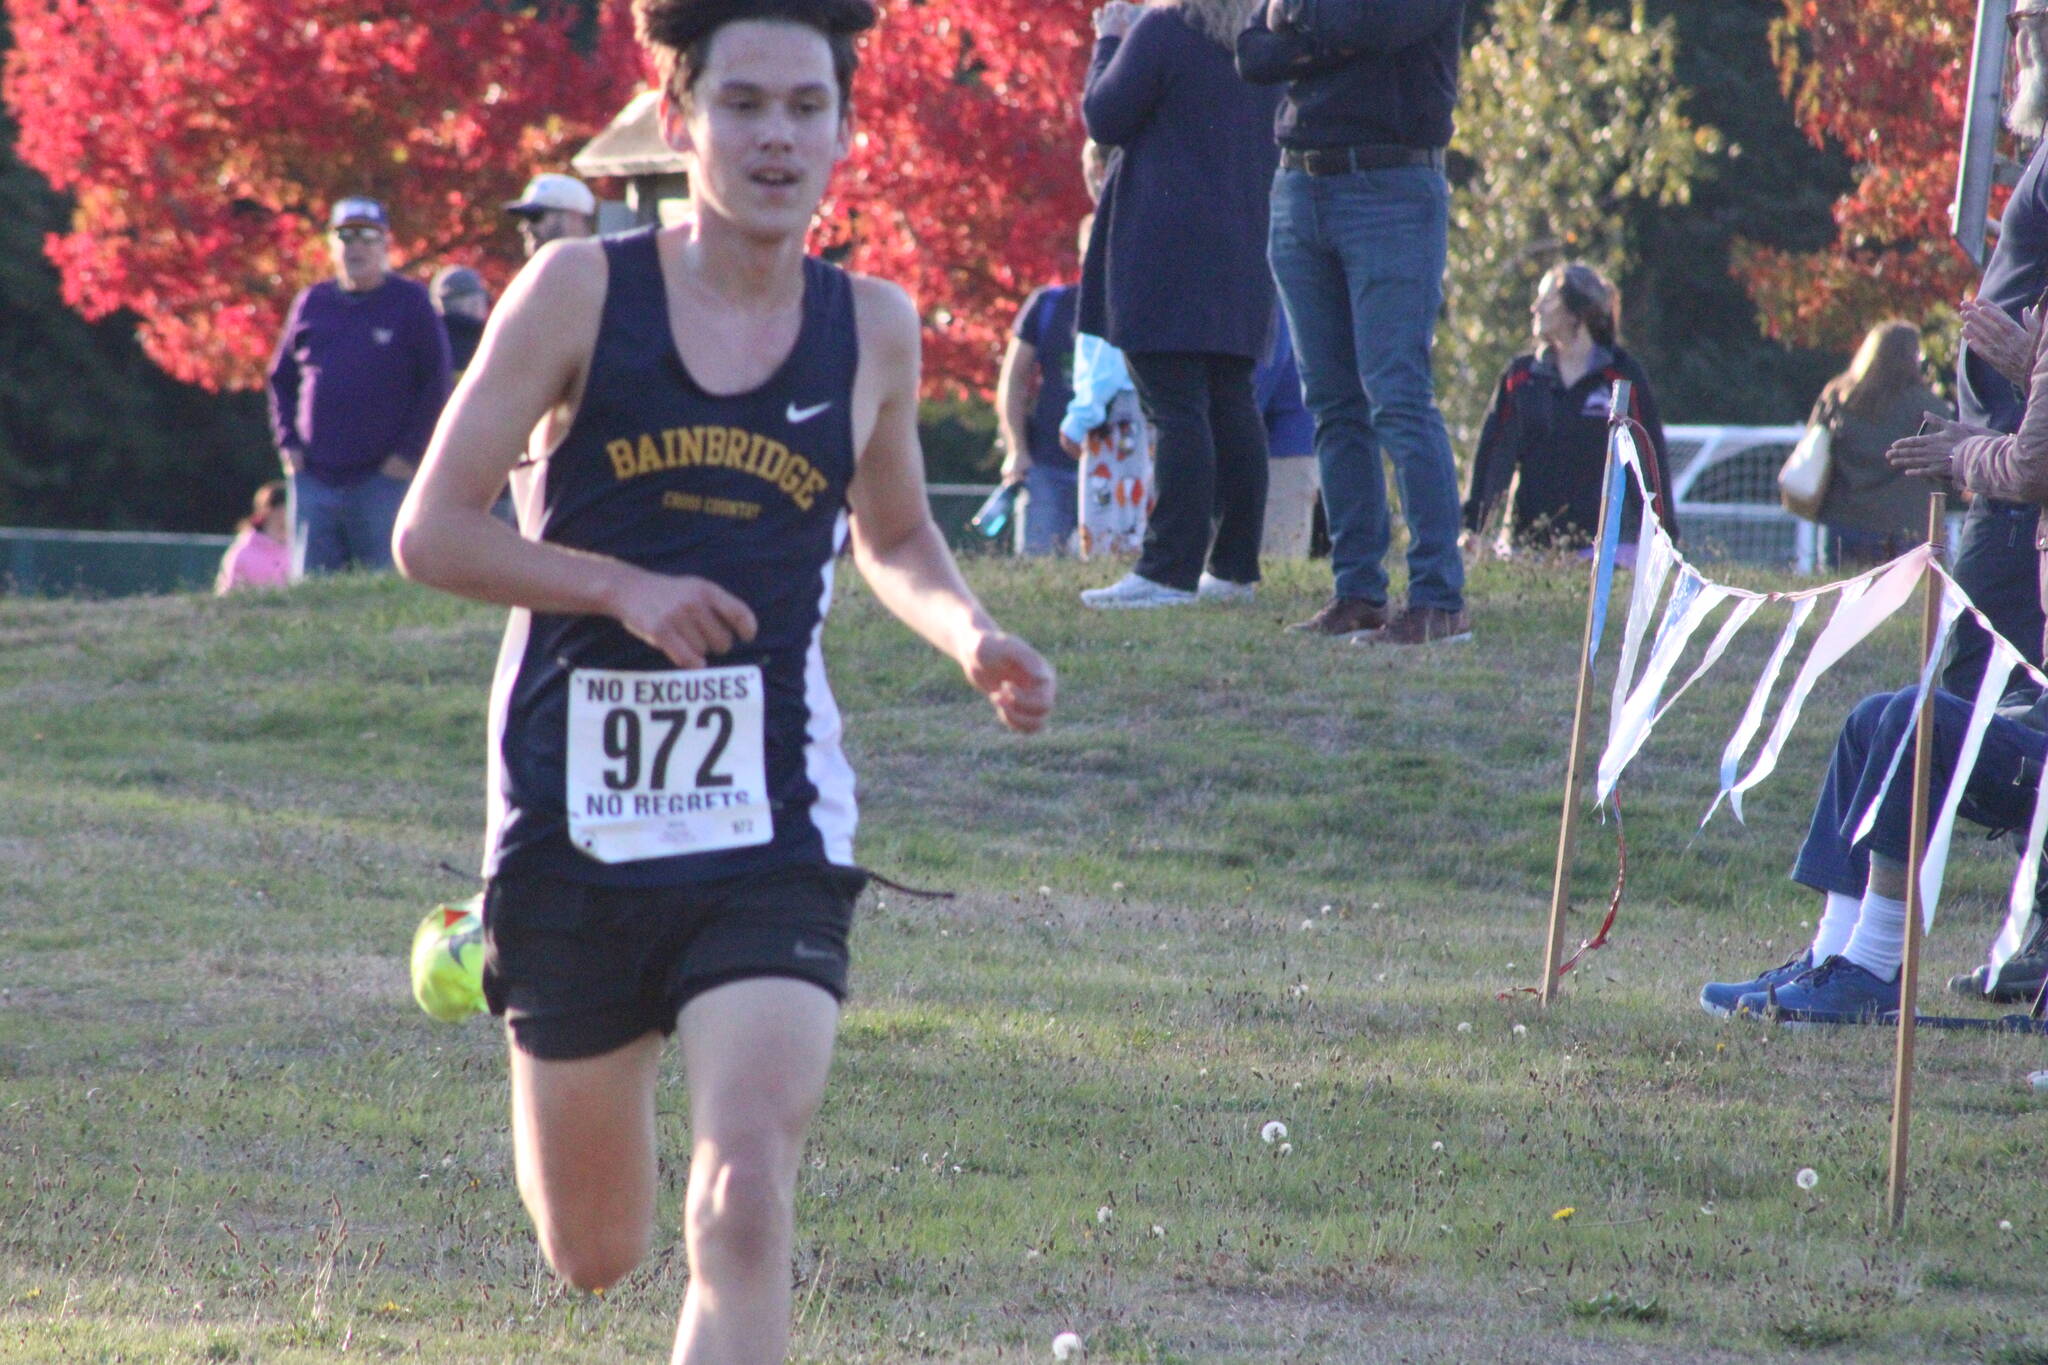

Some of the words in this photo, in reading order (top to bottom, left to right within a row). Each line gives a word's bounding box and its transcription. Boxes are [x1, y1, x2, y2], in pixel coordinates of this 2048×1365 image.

[606, 425, 828, 511] BAINBRIDGE
[587, 679, 623, 702] NO
[635, 676, 748, 703] EXCUSES
[603, 705, 733, 791] 972
[586, 794, 623, 816] NO
[634, 791, 749, 816] REGRETS
